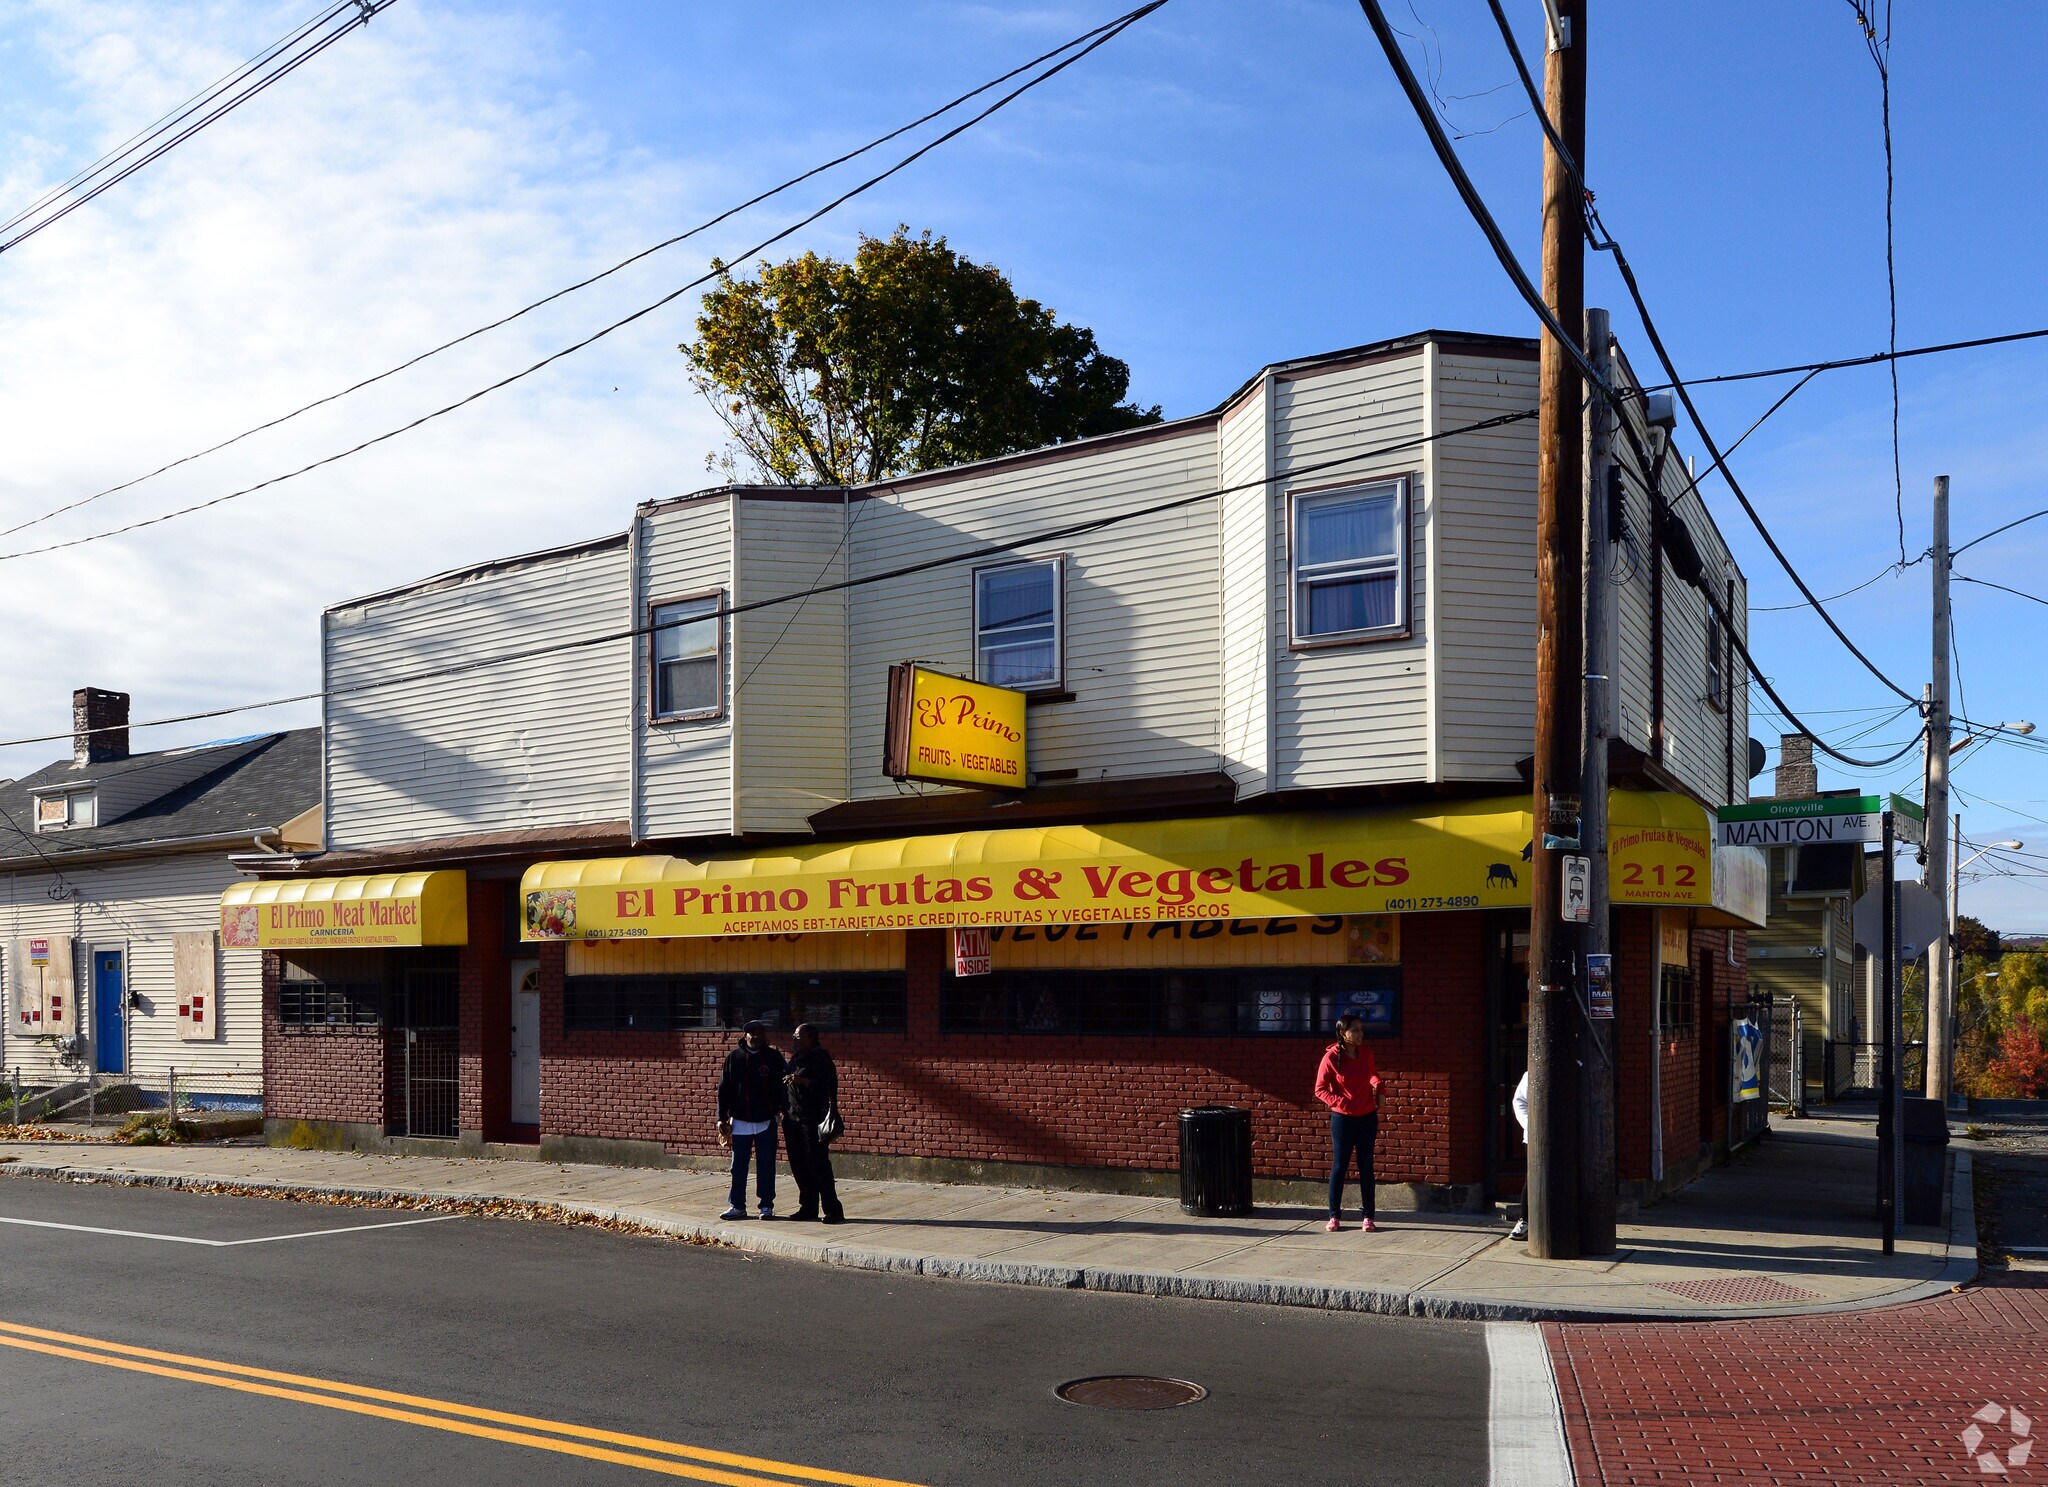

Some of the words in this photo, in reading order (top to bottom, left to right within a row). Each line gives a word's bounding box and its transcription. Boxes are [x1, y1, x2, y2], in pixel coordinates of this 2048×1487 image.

[916, 697, 946, 728] El
[950, 695, 1021, 743] Primo
[918, 746, 951, 767] FRUITS
[960, 753, 1018, 776] VEGETABLES
[1770, 803, 1824, 815] Olneyville
[1613, 842, 1620, 855] El
[1620, 833, 1639, 851] Primo
[1641, 830, 1665, 843] Frutas
[1667, 830, 1674, 843] &
[1676, 831, 1706, 859] Vegetales
[1726, 818, 1833, 845] MANTON
[1843, 815, 1871, 828] AVE.
[615, 888, 656, 918] El
[673, 884, 809, 916] Primo
[827, 873, 993, 909] Frutas
[1013, 867, 1063, 900] &
[1080, 852, 1410, 906] Vegetales
[1622, 862, 1696, 887] 212
[1385, 898, 1417, 912] (401)
[1420, 895, 1479, 909] 273-4890
[1625, 890, 1670, 898] MANTON
[271, 905, 283, 929] El
[287, 903, 325, 929] Primo
[333, 902, 365, 927] Meat
[370, 899, 417, 926] Market
[723, 918, 799, 934] ACEPTAMOS
[803, 914, 894, 930] EBT-TARJETAS
[896, 914, 914, 927] DE
[918, 909, 1043, 926] CREDITO-FRUTAS
[1047, 909, 1058, 922] Y
[1062, 906, 1151, 922] VEGETALES
[1157, 903, 1230, 919] FRESCOS
[310, 928, 355, 937] CARNICERIA
[585, 928, 607, 939] (401)
[608, 928, 648, 938] 273-4890
[957, 928, 990, 957] ATM
[957, 959, 990, 976] INSIDE
